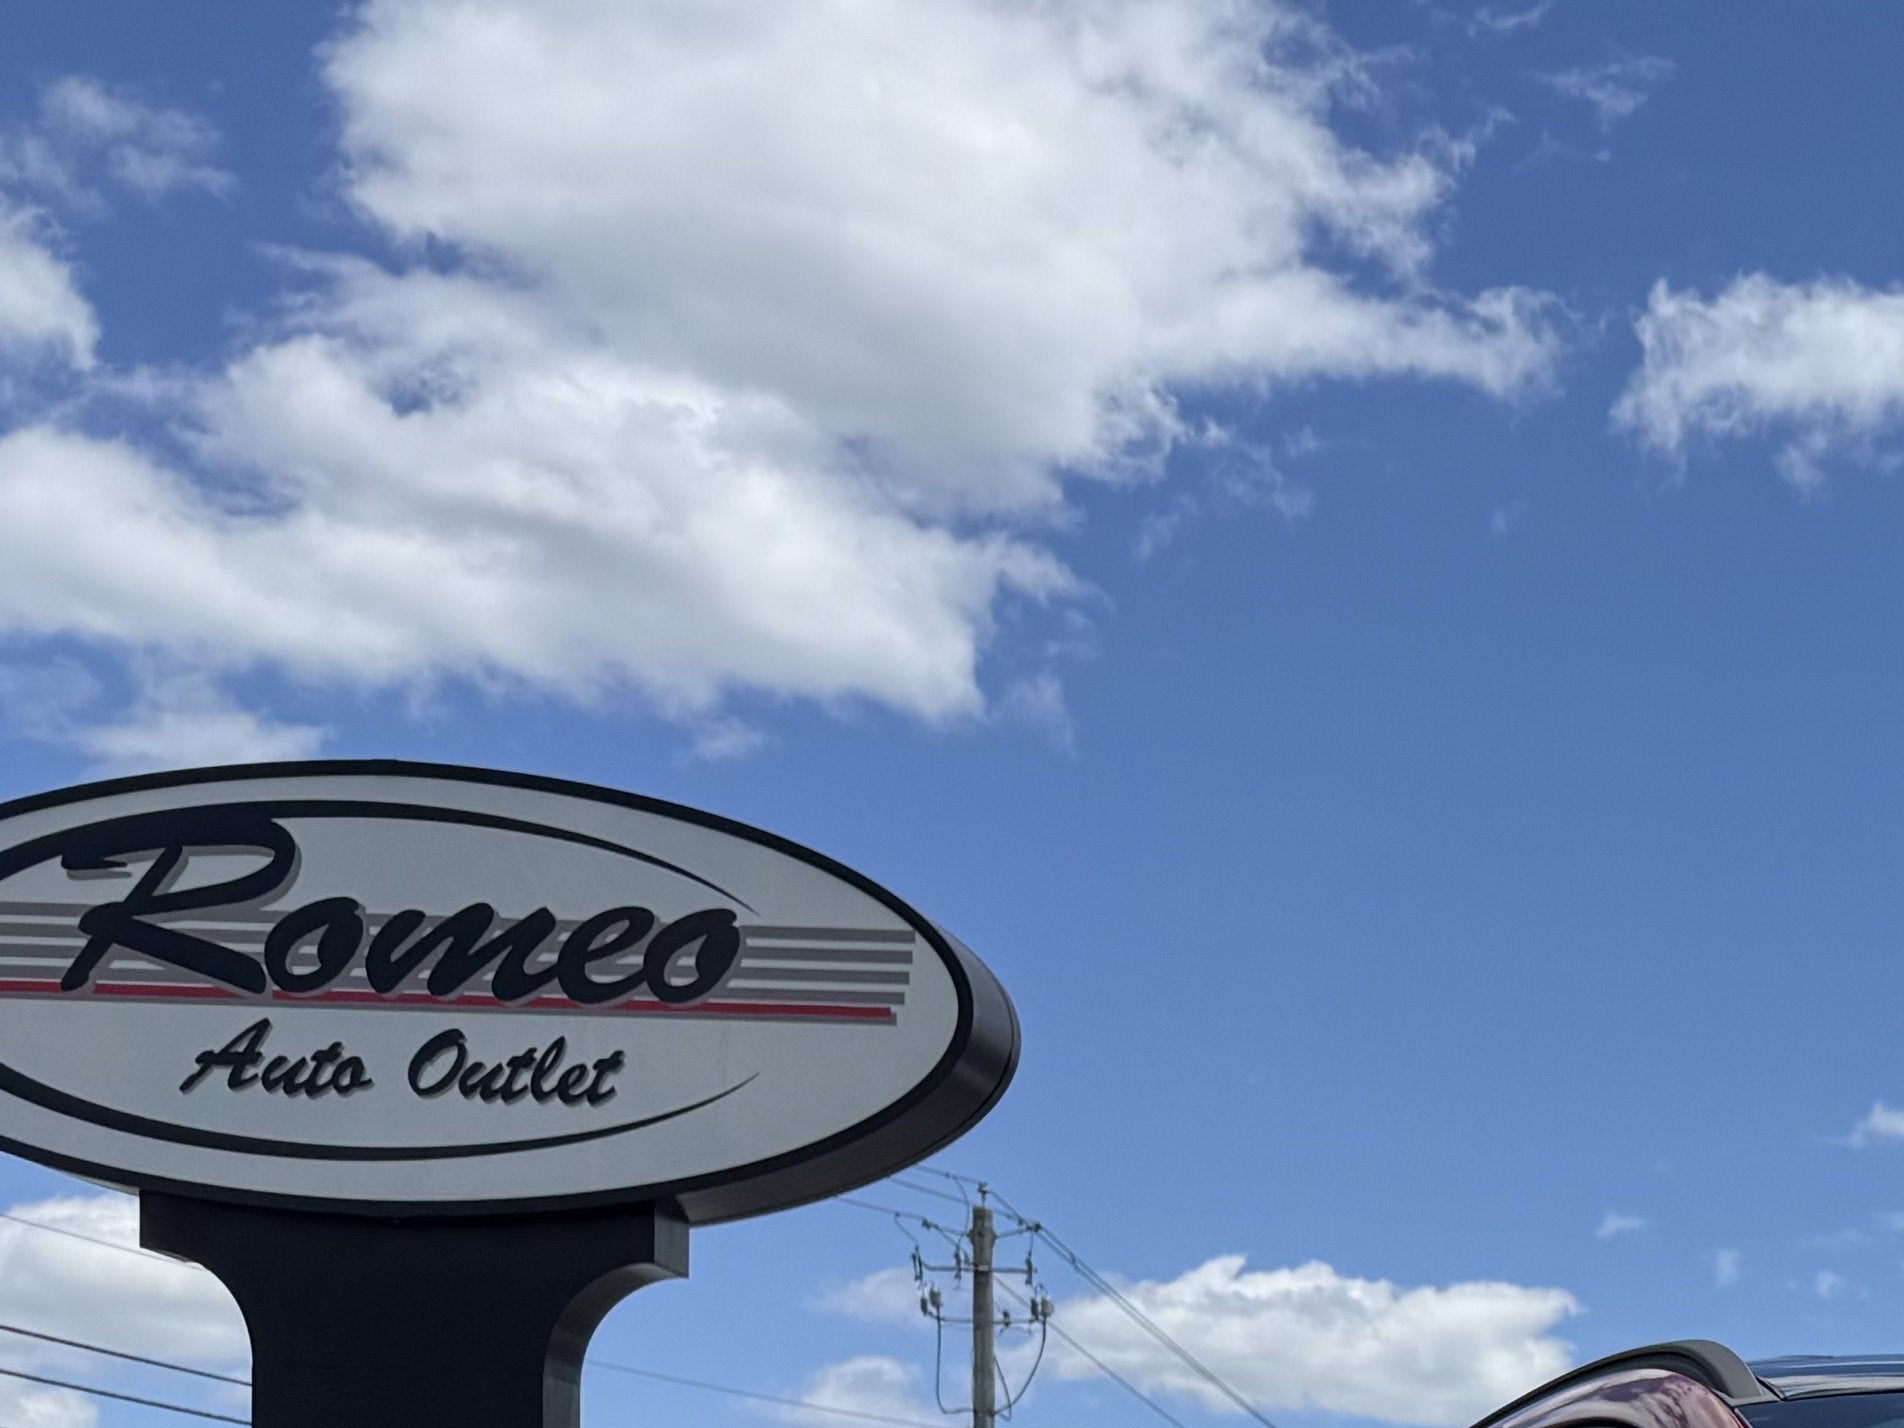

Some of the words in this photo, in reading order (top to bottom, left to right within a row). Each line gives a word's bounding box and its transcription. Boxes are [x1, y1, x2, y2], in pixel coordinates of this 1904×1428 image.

[60, 800, 742, 1005] Romeo
[180, 1017, 374, 1100] Auto
[407, 1028, 626, 1106] Outlet
